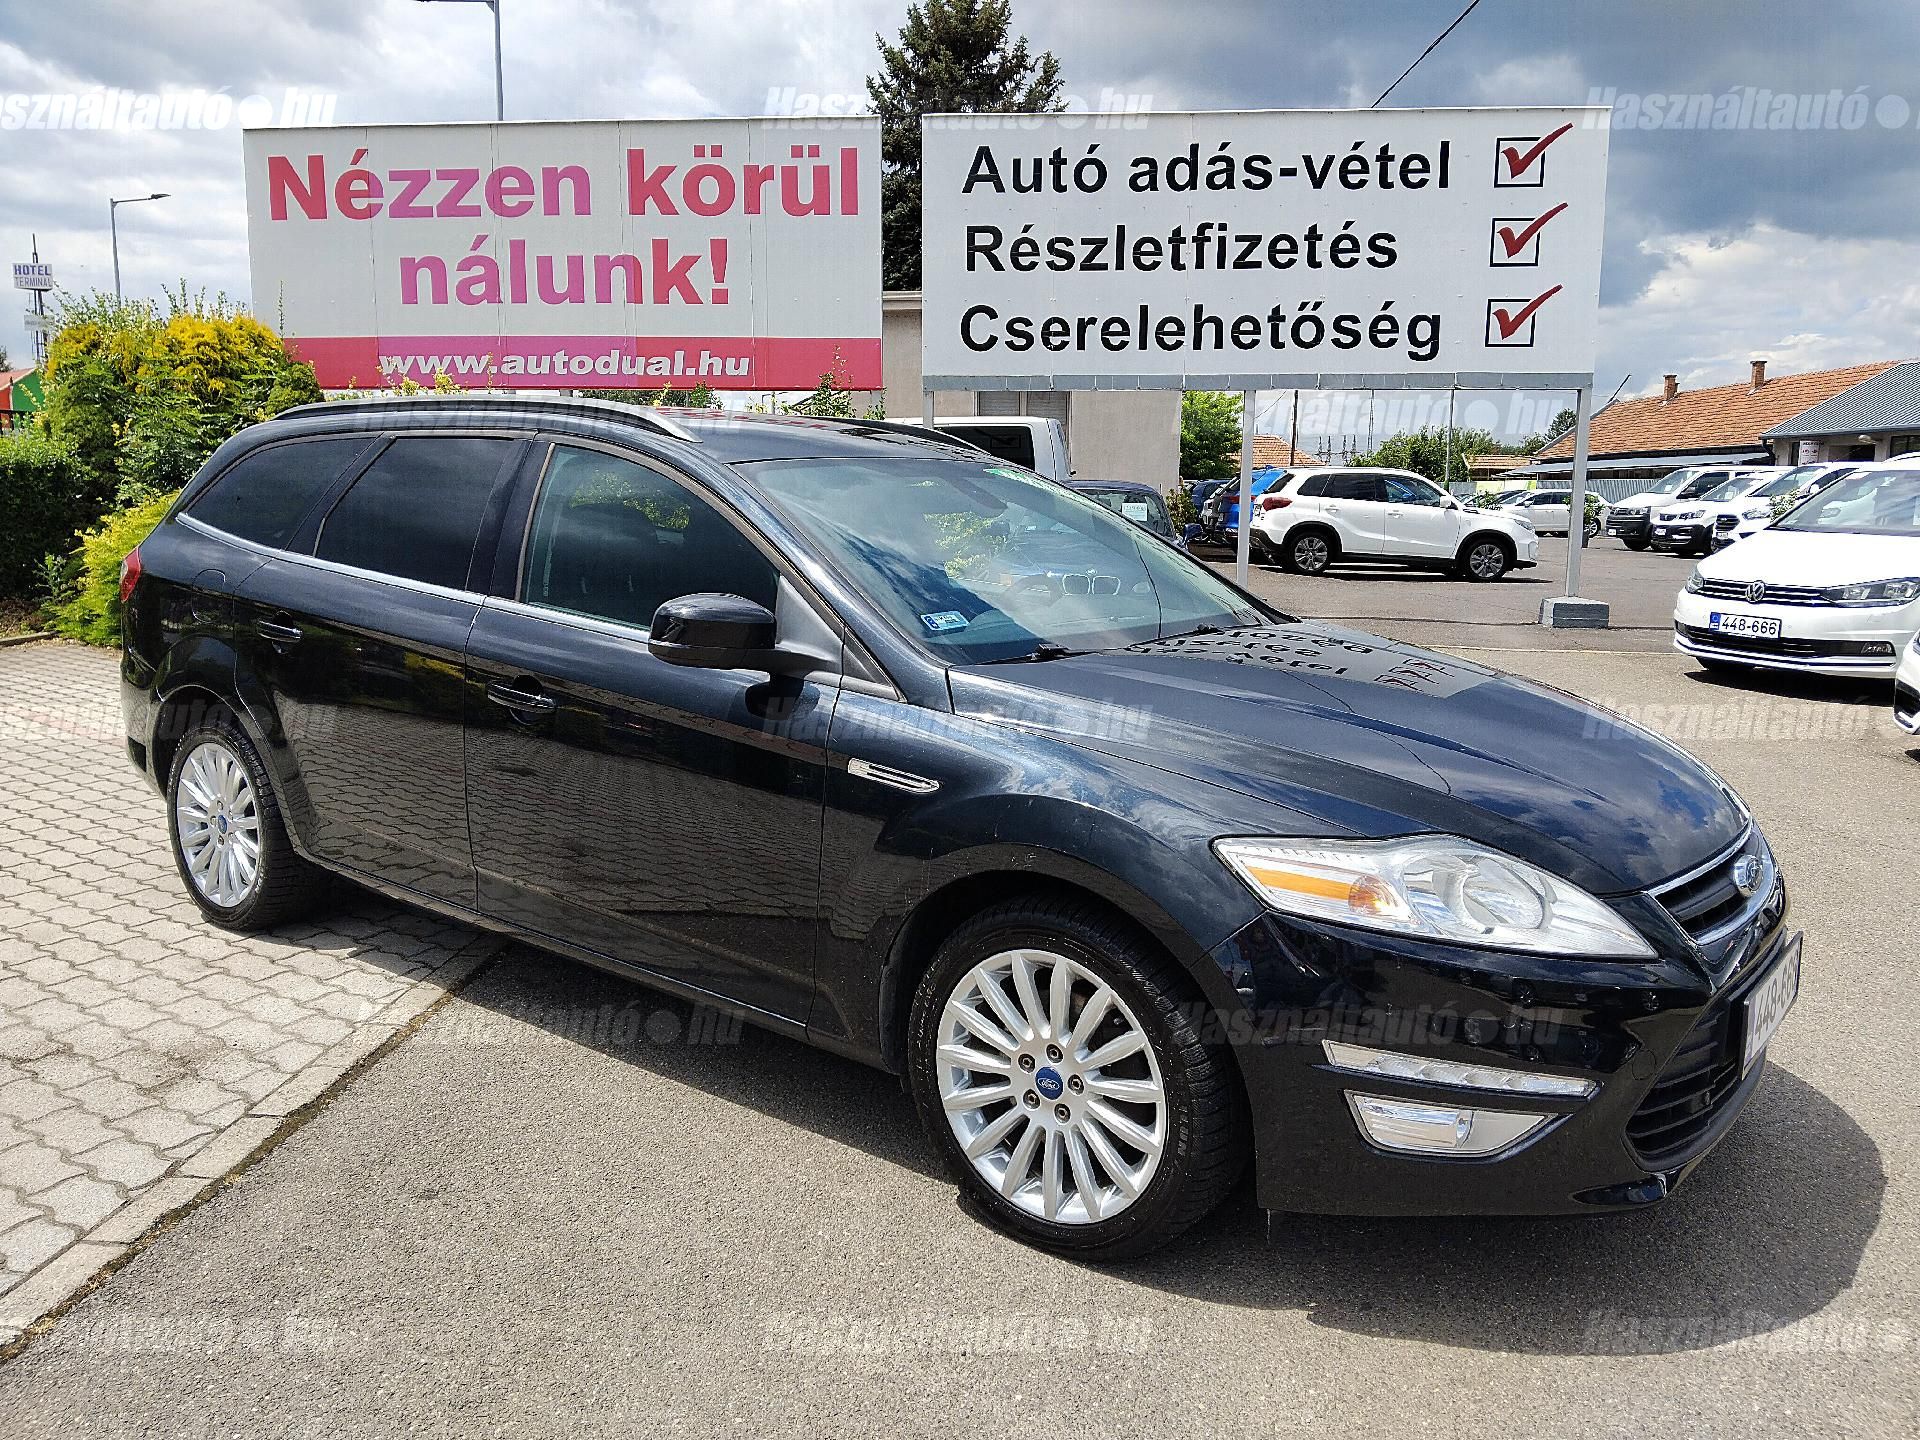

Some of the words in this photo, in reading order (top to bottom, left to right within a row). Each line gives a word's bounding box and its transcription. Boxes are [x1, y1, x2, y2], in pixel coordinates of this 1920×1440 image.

[268, 149, 590, 221] Nézzen
[628, 145, 859, 216] körül
[961, 143, 1108, 194] Autó
[1129, 141, 1451, 193] adás-vétel
[14, 264, 51, 275] HOTEL
[400, 235, 729, 306] nálunk!
[966, 220, 1398, 272] Részletfizetés
[14, 276, 52, 287] TERMINAL
[960, 301, 1441, 361] Cserelehetőség
[378, 349, 750, 377] www.autodual.hu
[1721, 616, 1777, 635] 448-666
